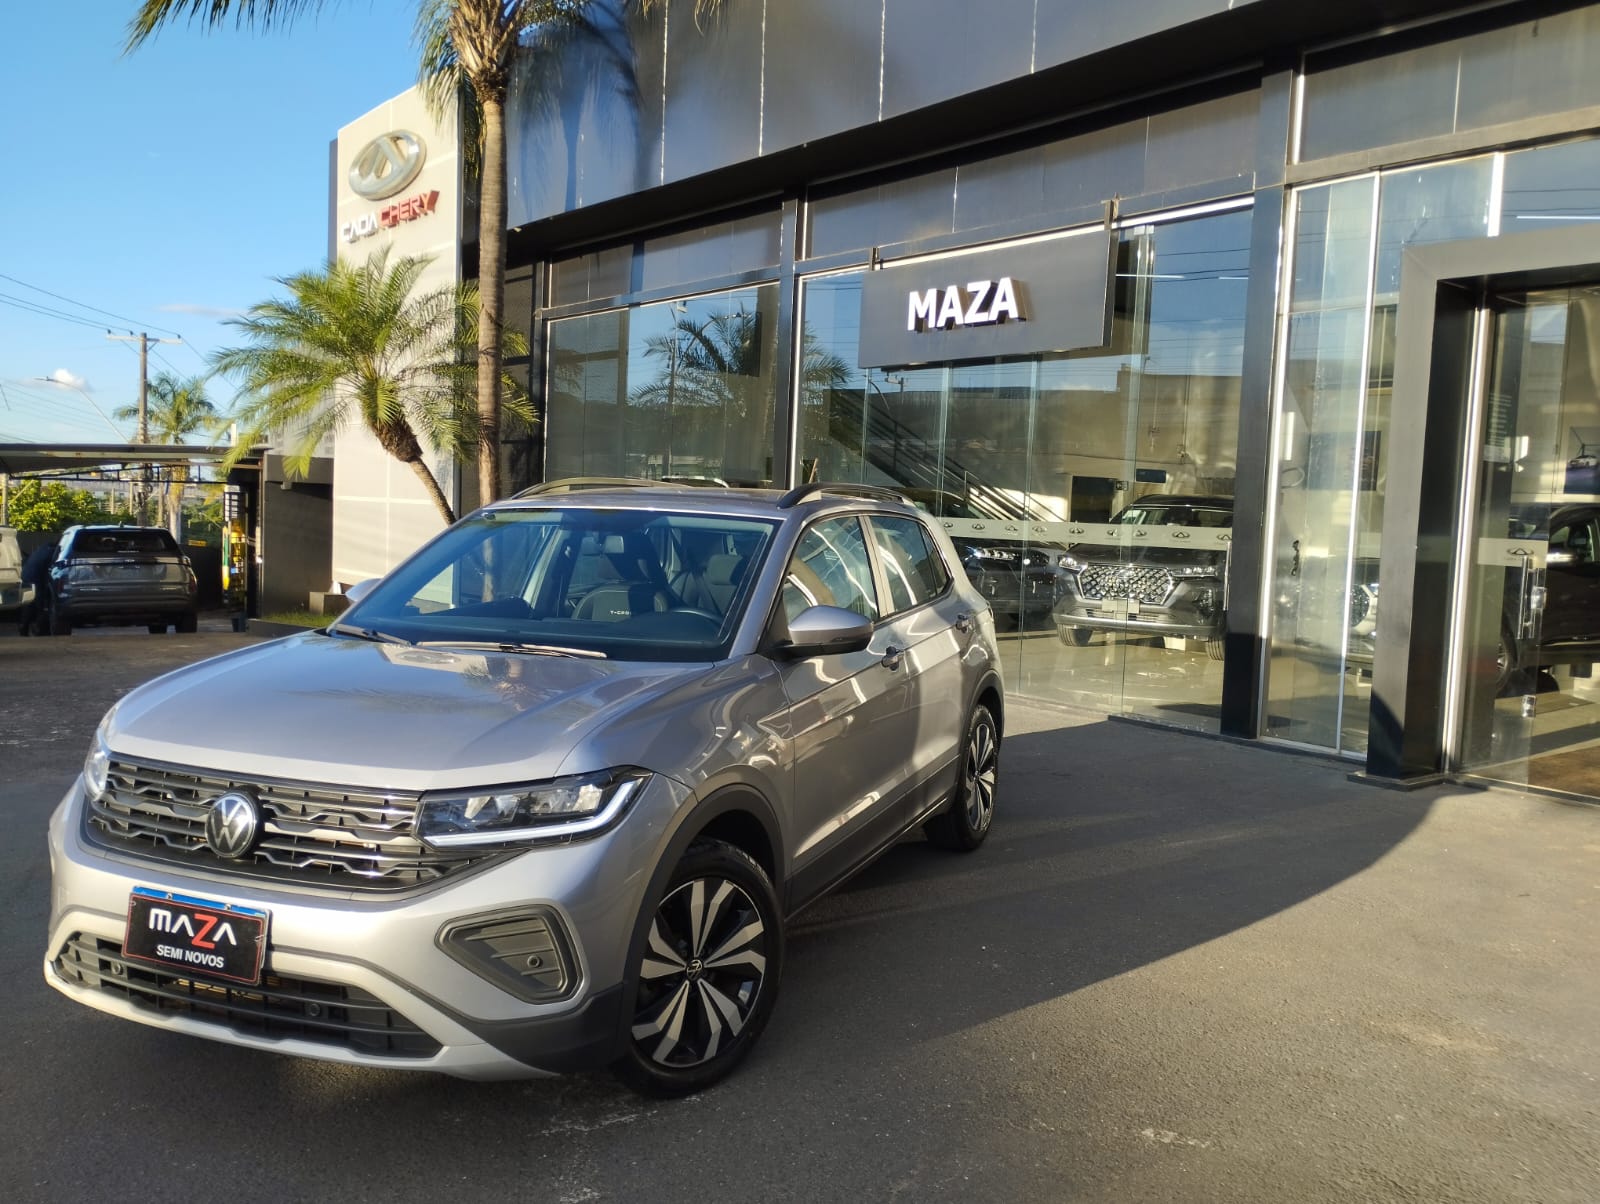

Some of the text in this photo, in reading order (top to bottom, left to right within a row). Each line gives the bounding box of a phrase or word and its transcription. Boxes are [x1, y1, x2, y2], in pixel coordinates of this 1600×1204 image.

[380, 190, 437, 229] CHERY
[907, 276, 1019, 331] MAZA
[156, 944, 225, 968] SEMI NOVOS
